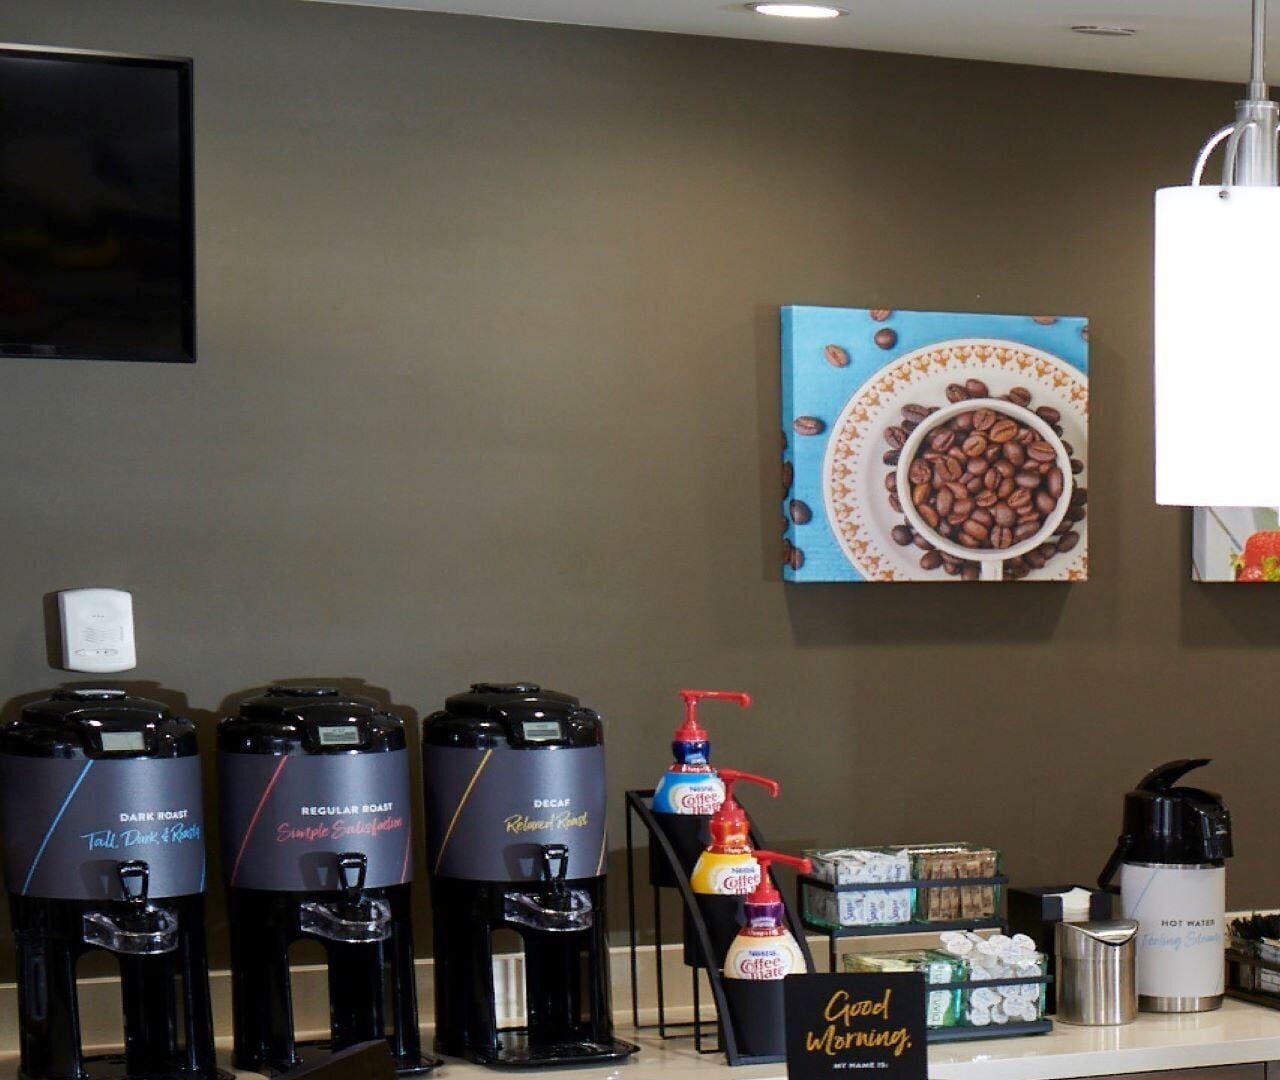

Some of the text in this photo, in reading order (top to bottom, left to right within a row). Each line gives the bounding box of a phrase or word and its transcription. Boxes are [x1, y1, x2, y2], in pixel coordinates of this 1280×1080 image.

[301, 802, 393, 816] REGULAR ROAST
[533, 798, 571, 809] DECAF
[681, 793, 719, 809] Coffee
[119, 809, 188, 822] DARK ROAST
[503, 809, 589, 835] Relaxed Roast
[275, 816, 403, 842] Simple Satisfaction
[1187, 919, 1216, 927] WATER
[740, 957, 782, 974] Coffee
[824, 987, 893, 1028] Good
[805, 1024, 913, 1057] Morning.
